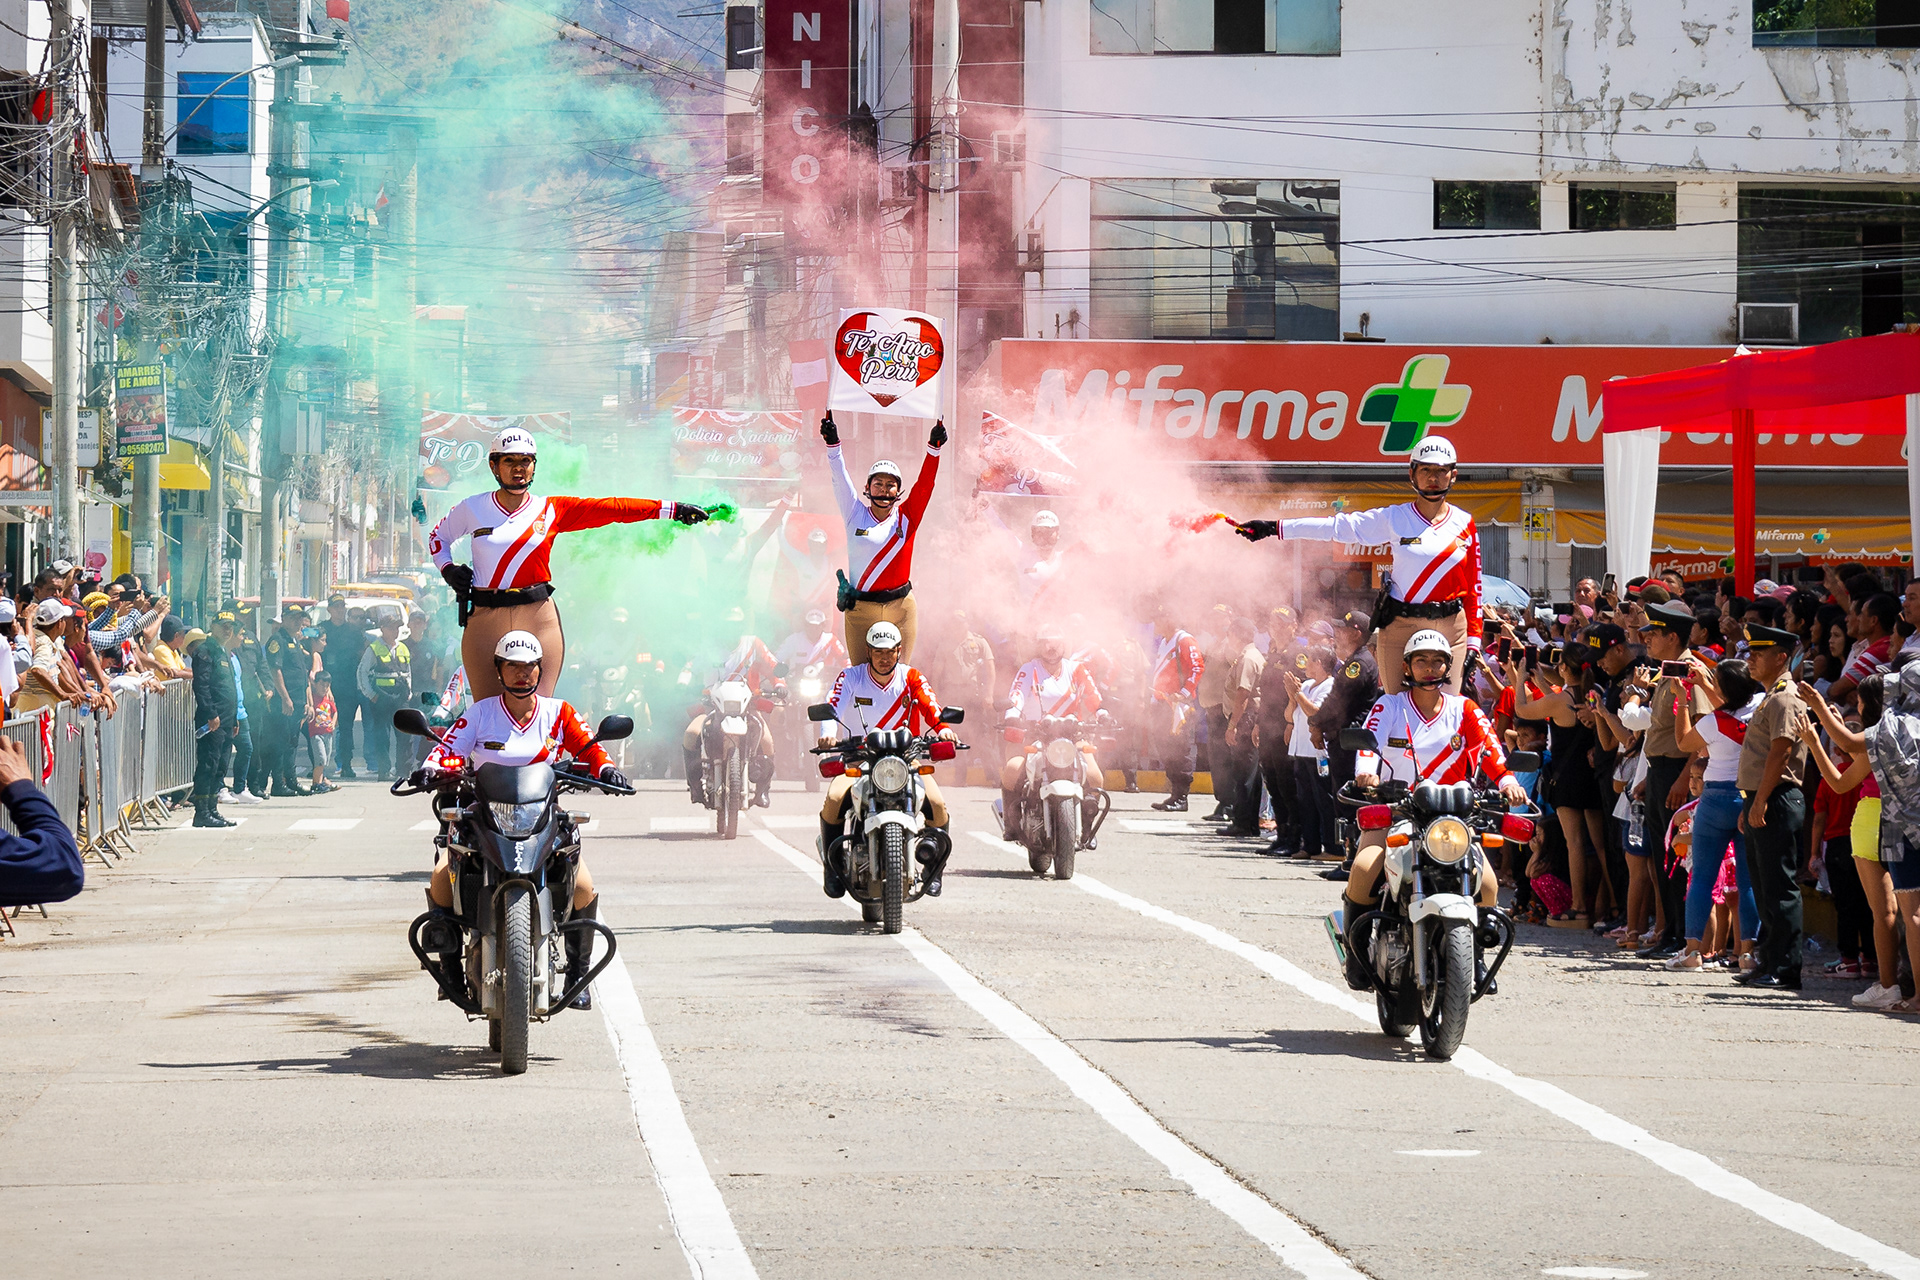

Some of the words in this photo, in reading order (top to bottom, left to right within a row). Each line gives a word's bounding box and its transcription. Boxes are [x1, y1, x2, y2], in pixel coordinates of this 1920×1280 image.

[844, 330, 877, 357] Te
[878, 332, 935, 363] Amo
[117, 365, 161, 378] AMARRES
[119, 377, 132, 388] DE
[134, 376, 160, 386] AMOR
[1032, 364, 1349, 441] Mifarma
[727, 429, 799, 448] Nacional
[424, 436, 458, 465] Te
[704, 449, 722, 464] de
[1280, 498, 1328, 510] Mifarma
[1755, 530, 1805, 541] Mifarma
